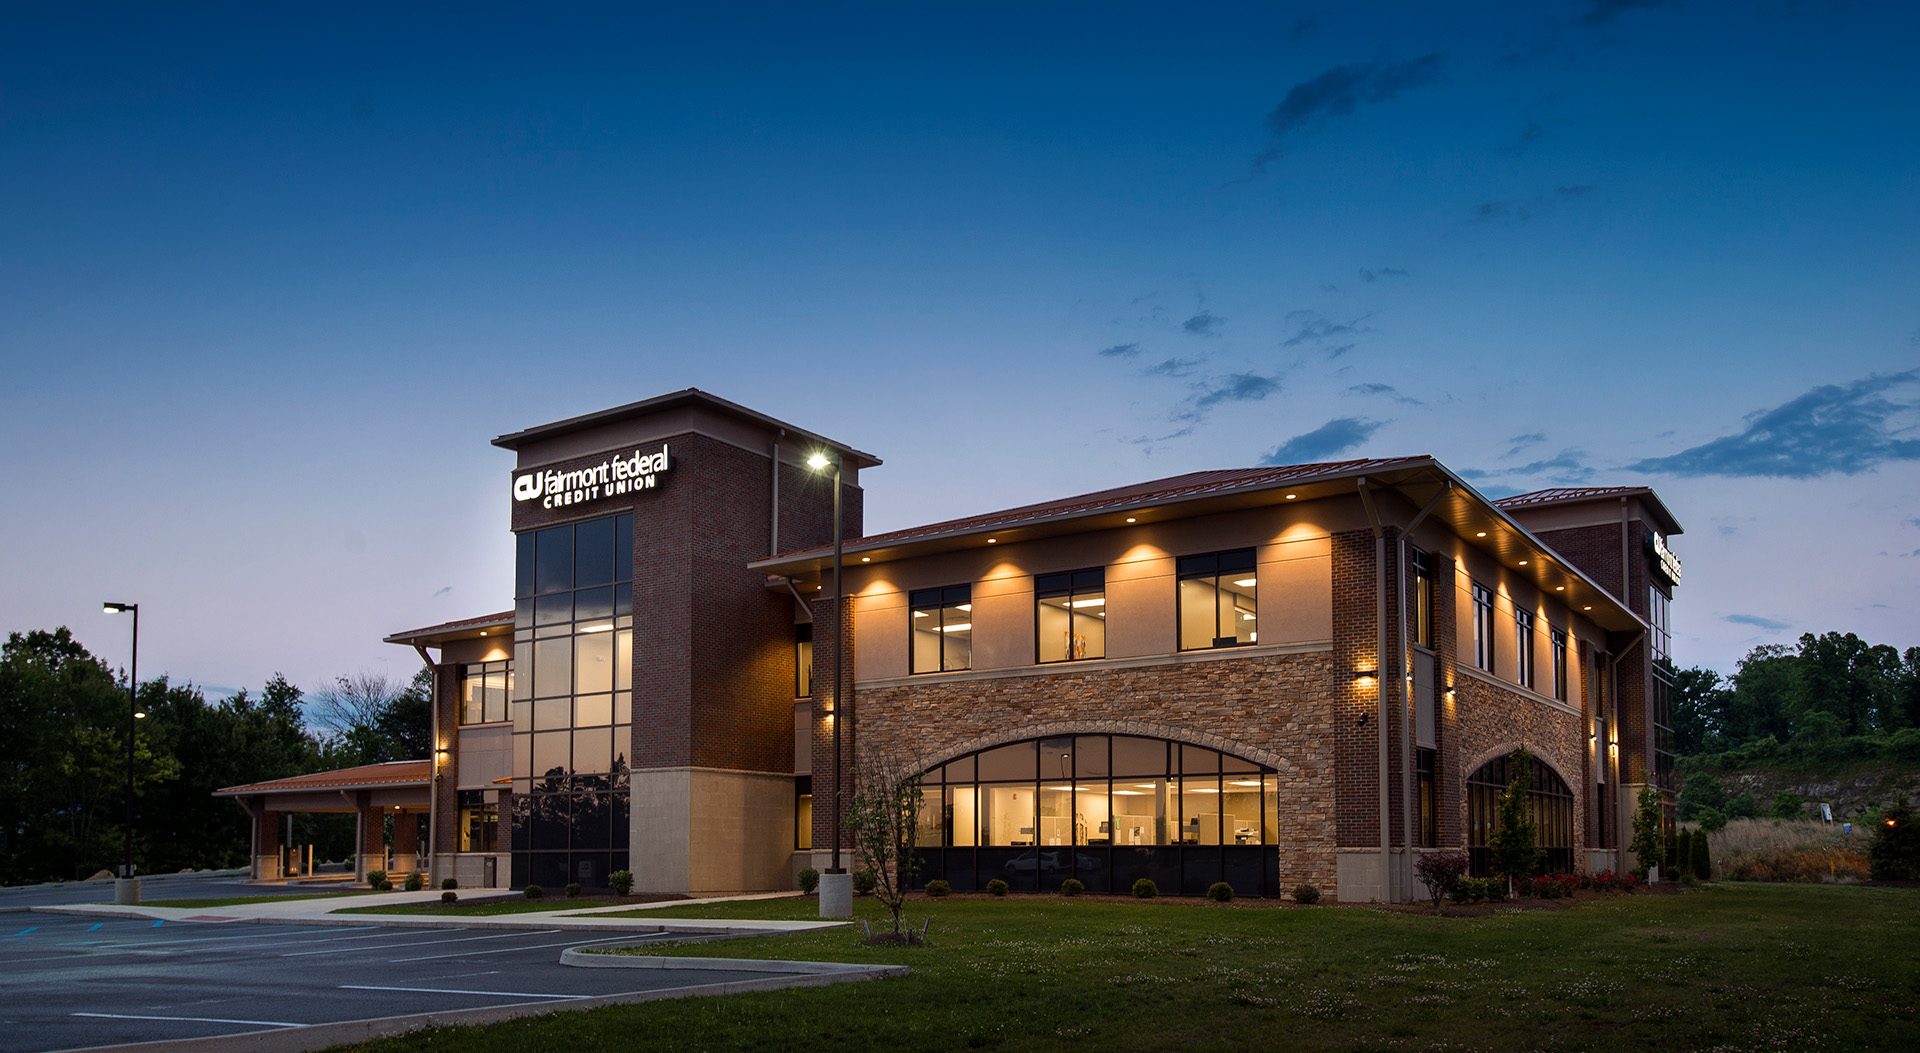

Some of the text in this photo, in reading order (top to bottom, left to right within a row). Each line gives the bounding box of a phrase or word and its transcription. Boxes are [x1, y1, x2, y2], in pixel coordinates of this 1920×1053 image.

[544, 461, 609, 495] fairmont
[611, 444, 668, 481] federal
[543, 474, 655, 509] CREDIT UNION
